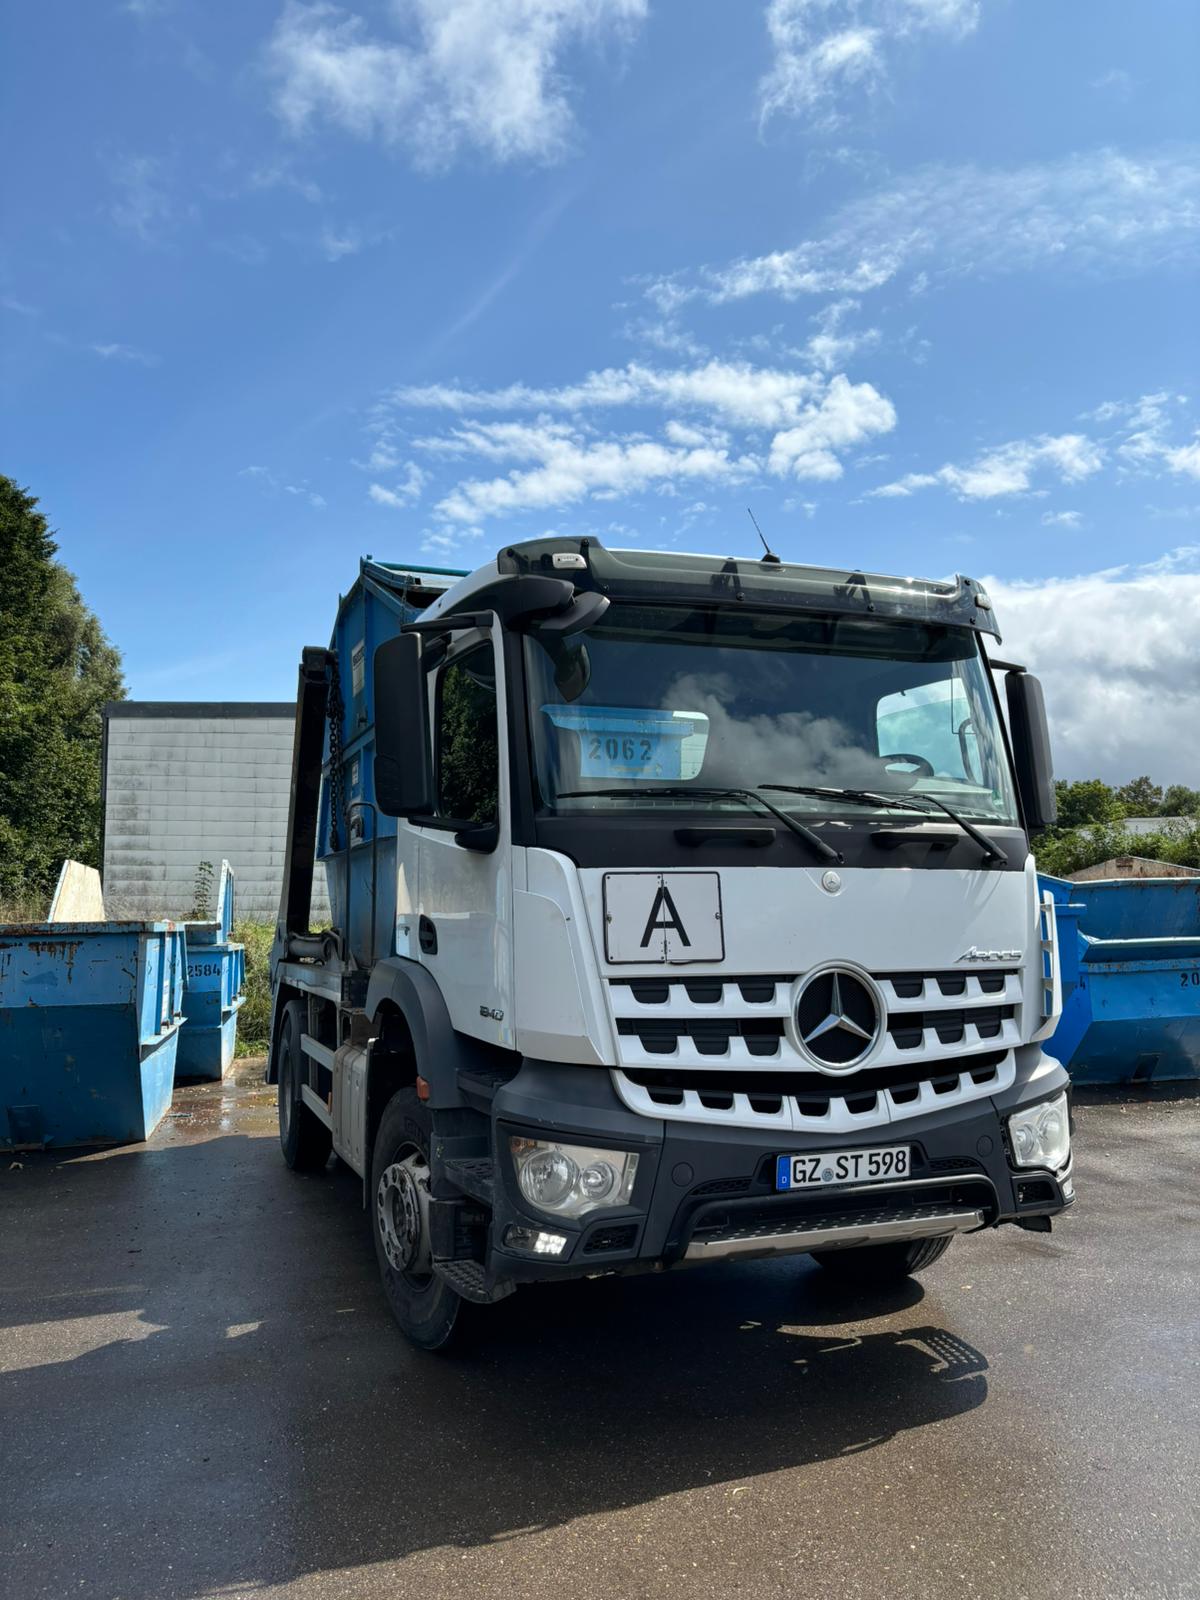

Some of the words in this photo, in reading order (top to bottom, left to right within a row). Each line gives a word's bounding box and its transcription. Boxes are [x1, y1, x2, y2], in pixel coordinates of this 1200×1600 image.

[588, 737, 652, 761] 2062
[639, 886, 692, 948] A
[187, 963, 221, 978] 2584
[792, 1157, 822, 1184] GZ
[835, 1154, 864, 1180] ST
[868, 1150, 907, 1176] 598
[781, 1176, 788, 1184] D
